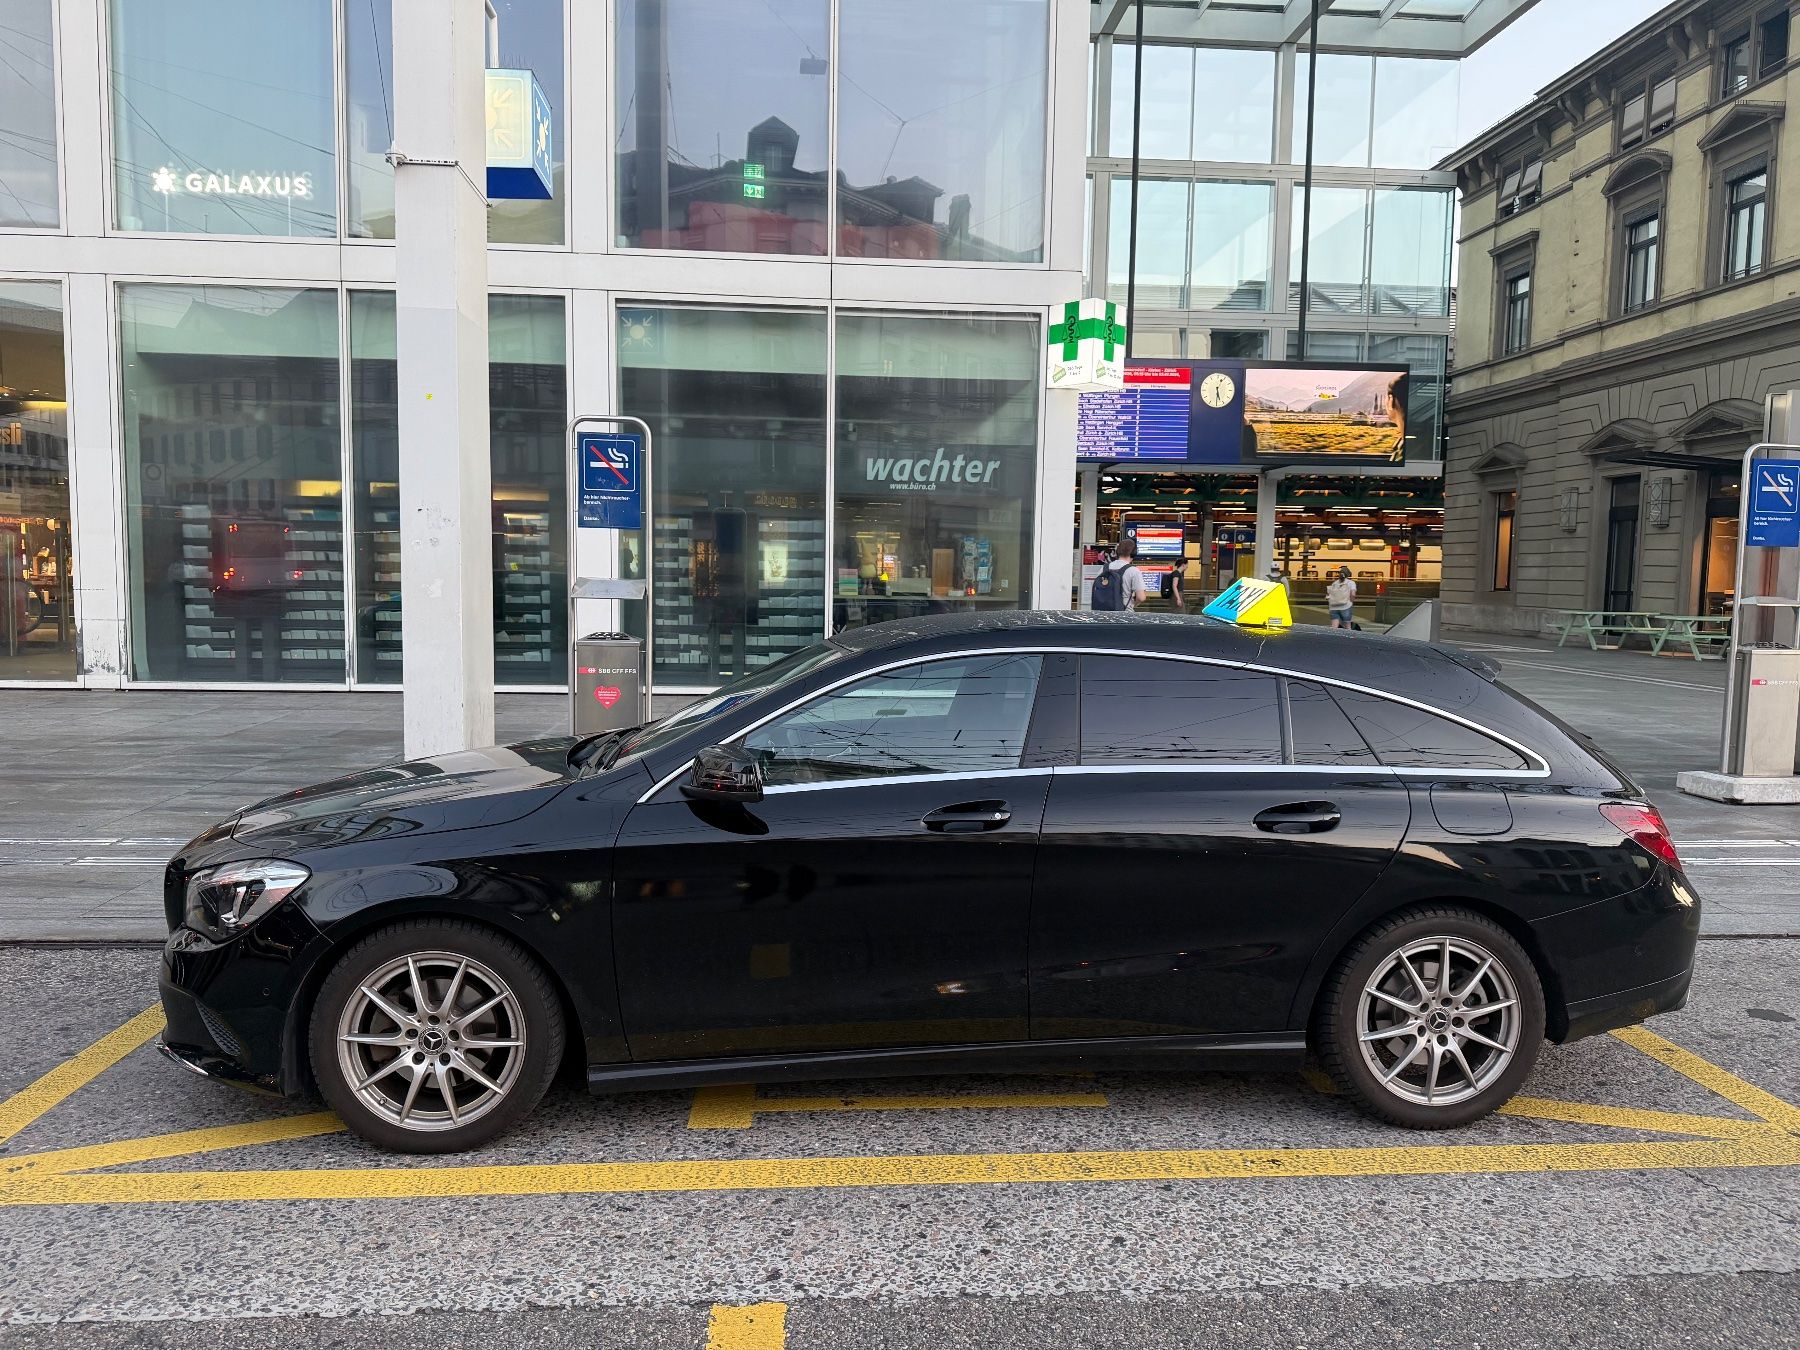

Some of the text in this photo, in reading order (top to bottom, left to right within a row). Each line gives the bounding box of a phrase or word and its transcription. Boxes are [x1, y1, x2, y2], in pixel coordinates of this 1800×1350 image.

[185, 173, 308, 196] GALAXUS
[0, 422, 22, 445] sli
[866, 447, 1001, 483] wachter
[889, 482, 937, 491] www.büro.ch
[1216, 585, 1268, 613] TAXI
